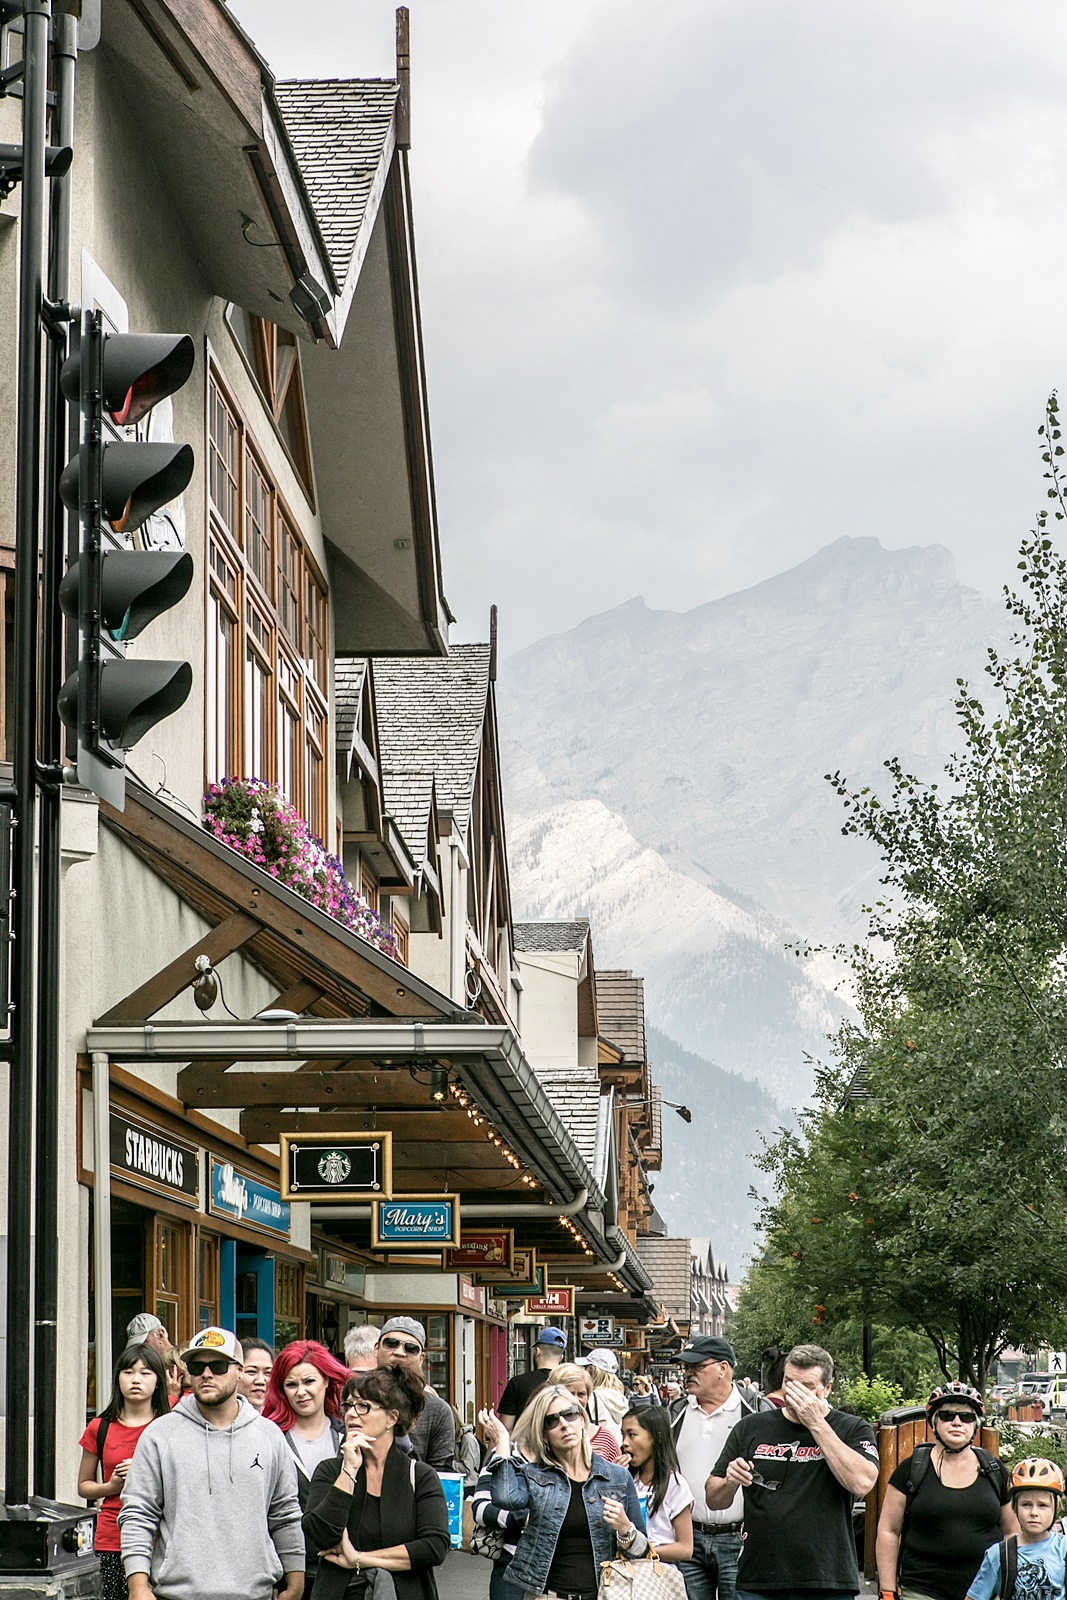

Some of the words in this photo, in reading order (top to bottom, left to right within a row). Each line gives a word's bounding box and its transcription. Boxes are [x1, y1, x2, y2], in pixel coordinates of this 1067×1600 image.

[125, 1127, 184, 1188] STARBUCKS
[384, 1209, 446, 1233] Mary's
[754, 1443, 790, 1457] SKY
